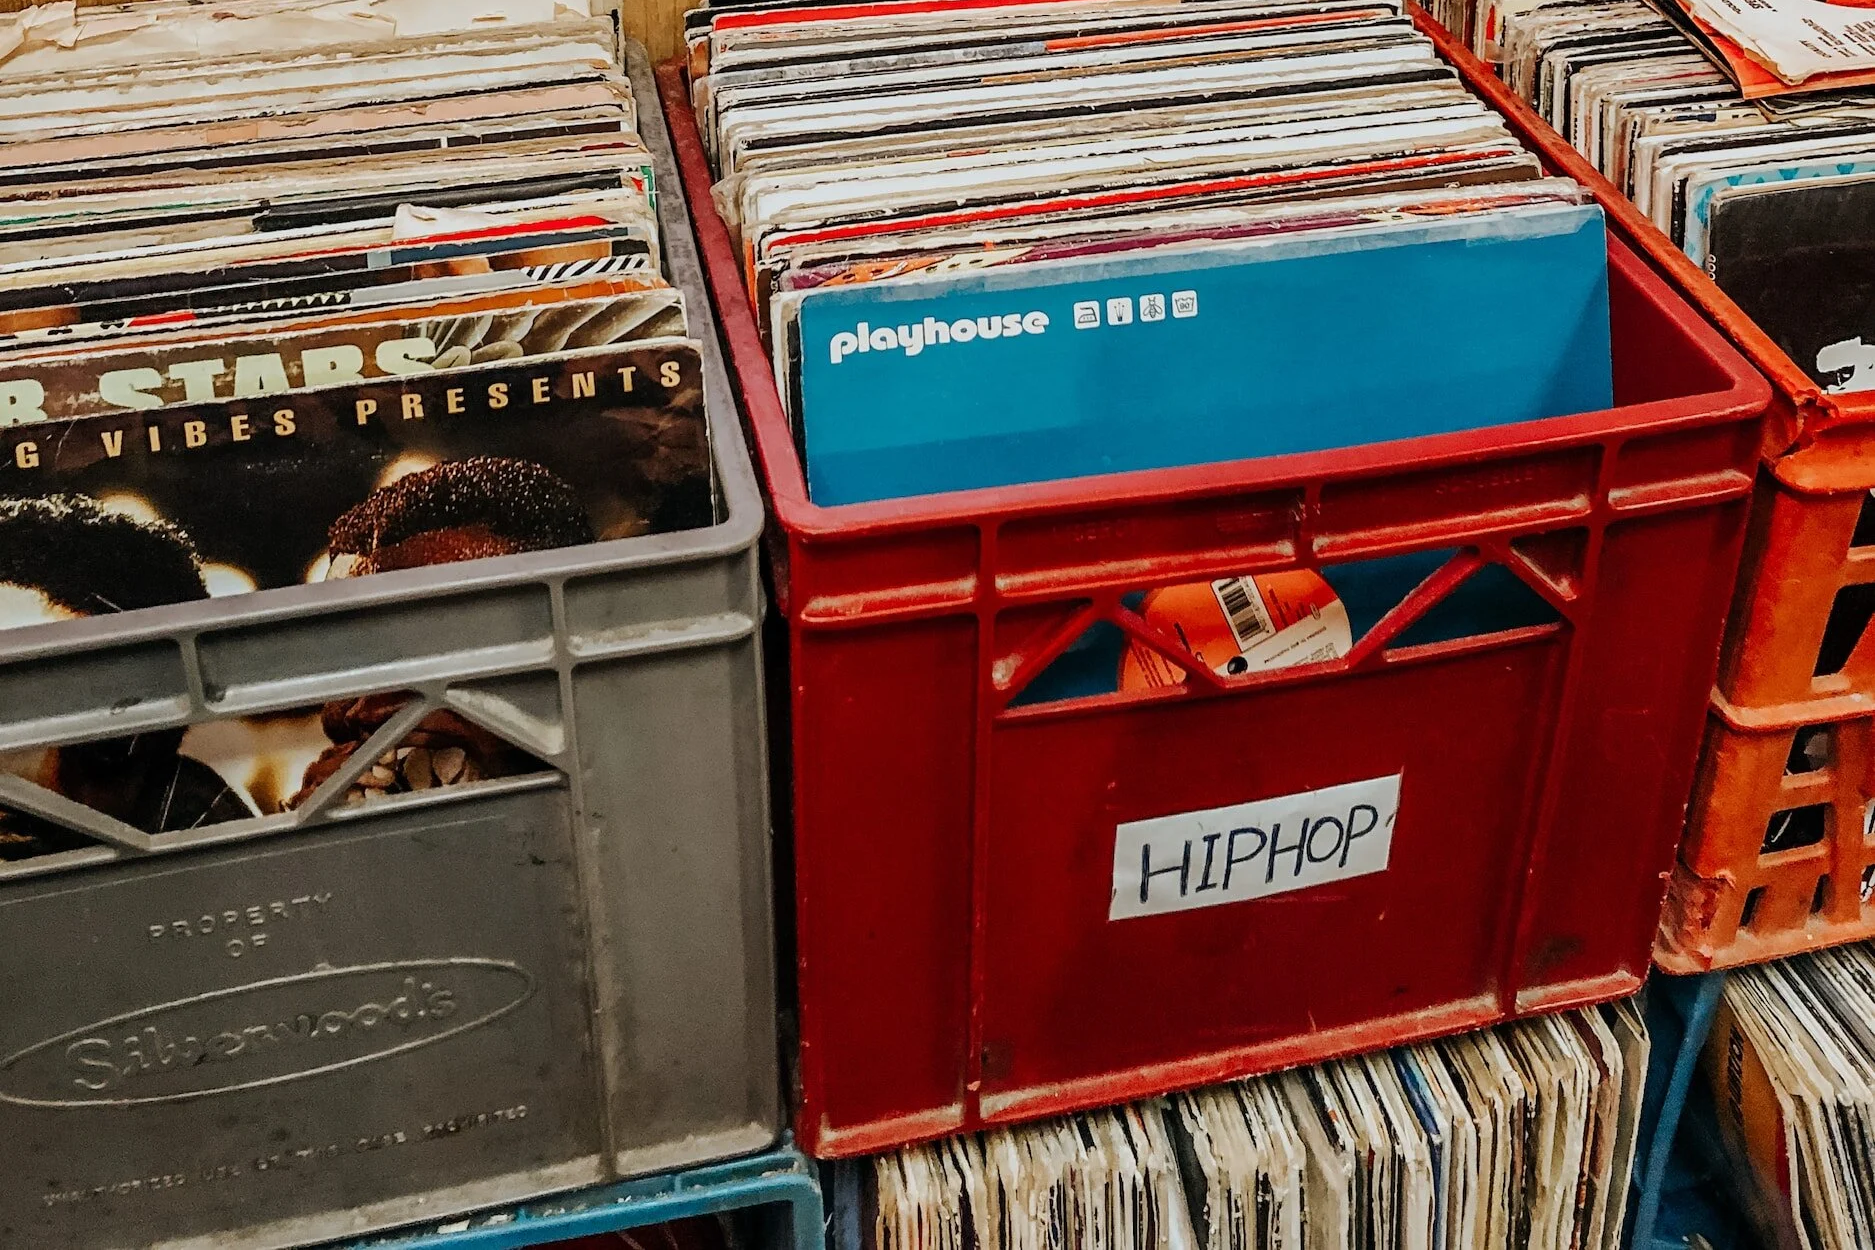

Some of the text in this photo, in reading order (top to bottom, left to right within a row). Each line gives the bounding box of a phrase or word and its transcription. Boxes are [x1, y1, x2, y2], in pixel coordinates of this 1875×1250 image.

[830, 310, 1050, 364] playhouse
[98, 336, 438, 411] STARS
[101, 408, 297, 459] VIBES
[356, 360, 683, 426] PRESENTS
[1140, 804, 1378, 903] HIPHOP
[149, 891, 334, 939] PROPERTY
[224, 933, 267, 958] OF
